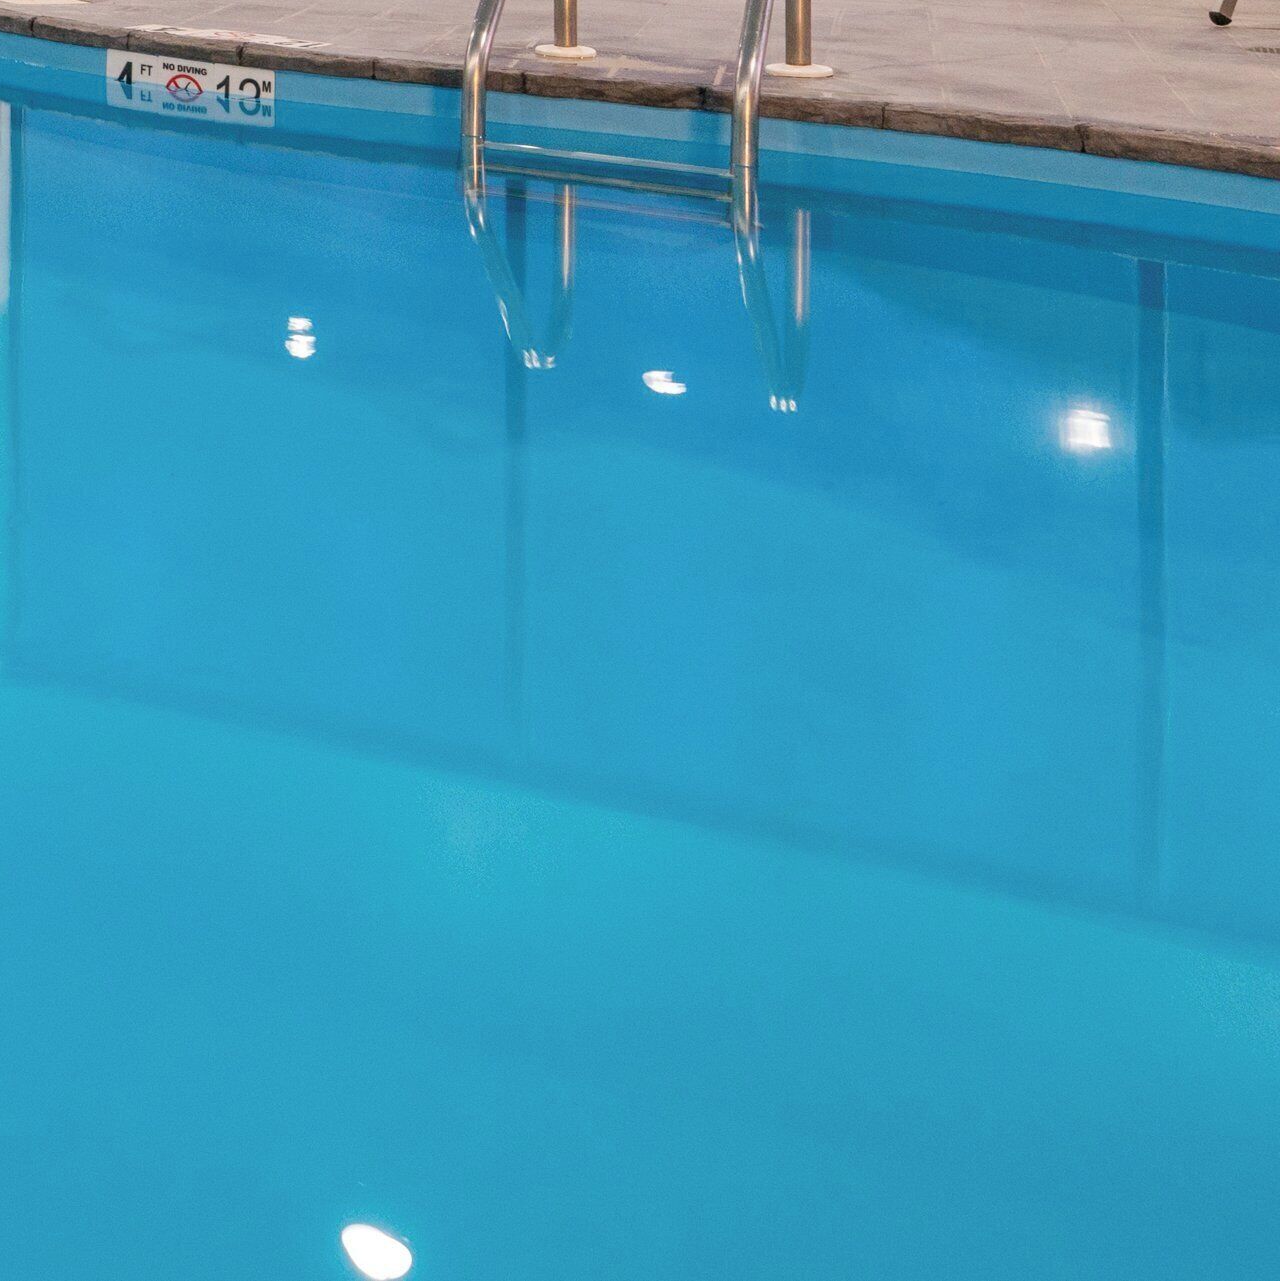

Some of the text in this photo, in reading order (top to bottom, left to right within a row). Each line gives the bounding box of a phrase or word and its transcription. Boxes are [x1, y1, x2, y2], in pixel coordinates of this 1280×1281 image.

[140, 64, 153, 77] FT
[162, 62, 208, 76] NO DIVING
[262, 80, 272, 94] M
